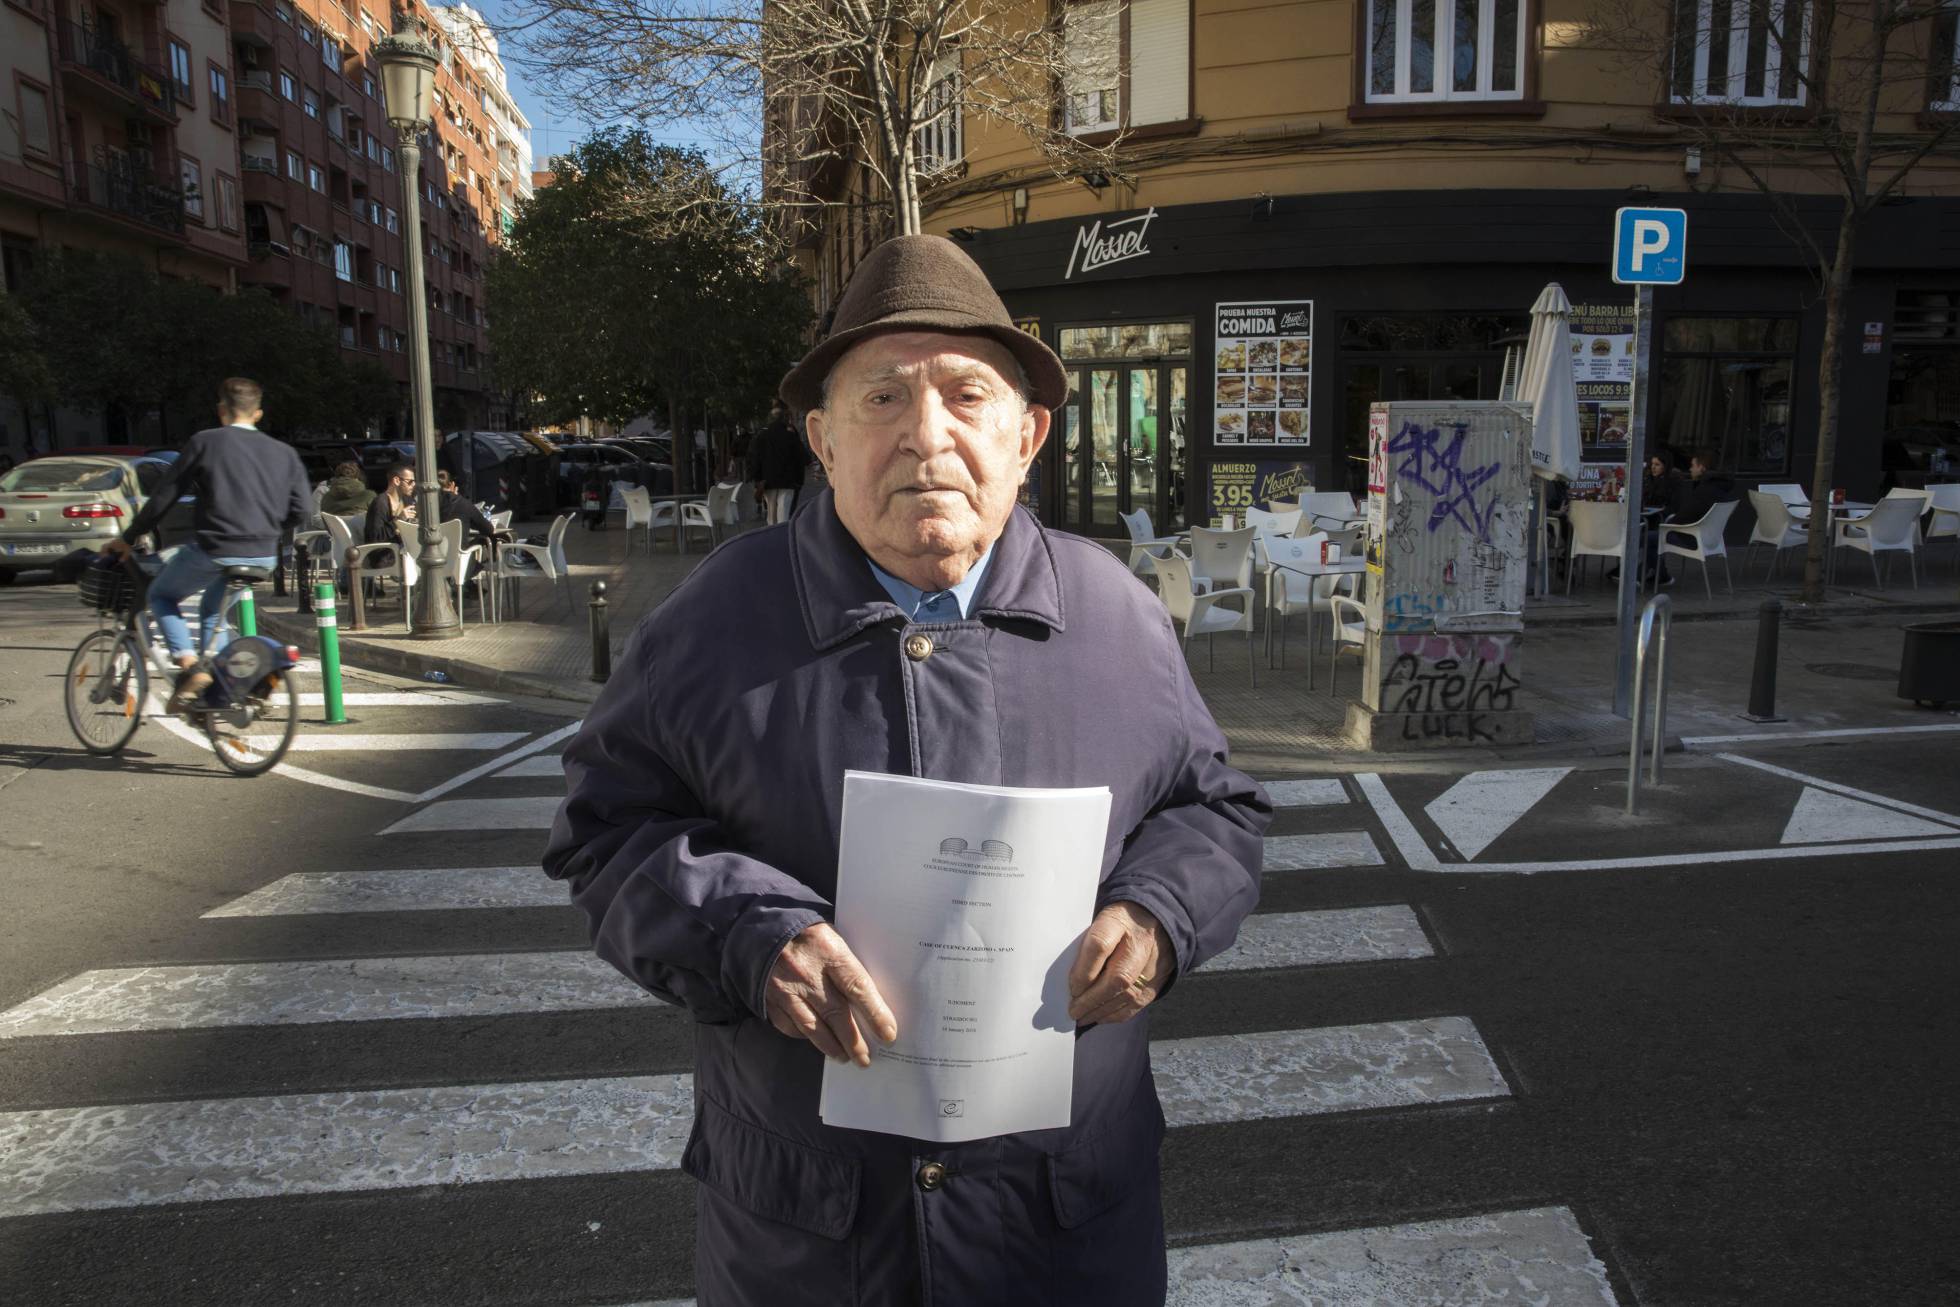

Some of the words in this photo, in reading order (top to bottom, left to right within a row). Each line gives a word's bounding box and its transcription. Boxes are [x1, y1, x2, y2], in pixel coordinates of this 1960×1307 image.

[1065, 206, 1158, 279] Mosset
[1631, 219, 1670, 272] P
[1219, 308, 1246, 317] PRUEBA
[1246, 307, 1277, 316] NUESTRA
[1570, 303, 1587, 316] ENÚ
[1589, 305, 1619, 316] BARRA
[1219, 317, 1276, 334] COMIDA
[1589, 384, 1614, 395] LOCOS
[1211, 463, 1257, 473] ALMUERZO
[1580, 468, 1600, 479] UNA
[1212, 485, 1253, 506] 3.95
